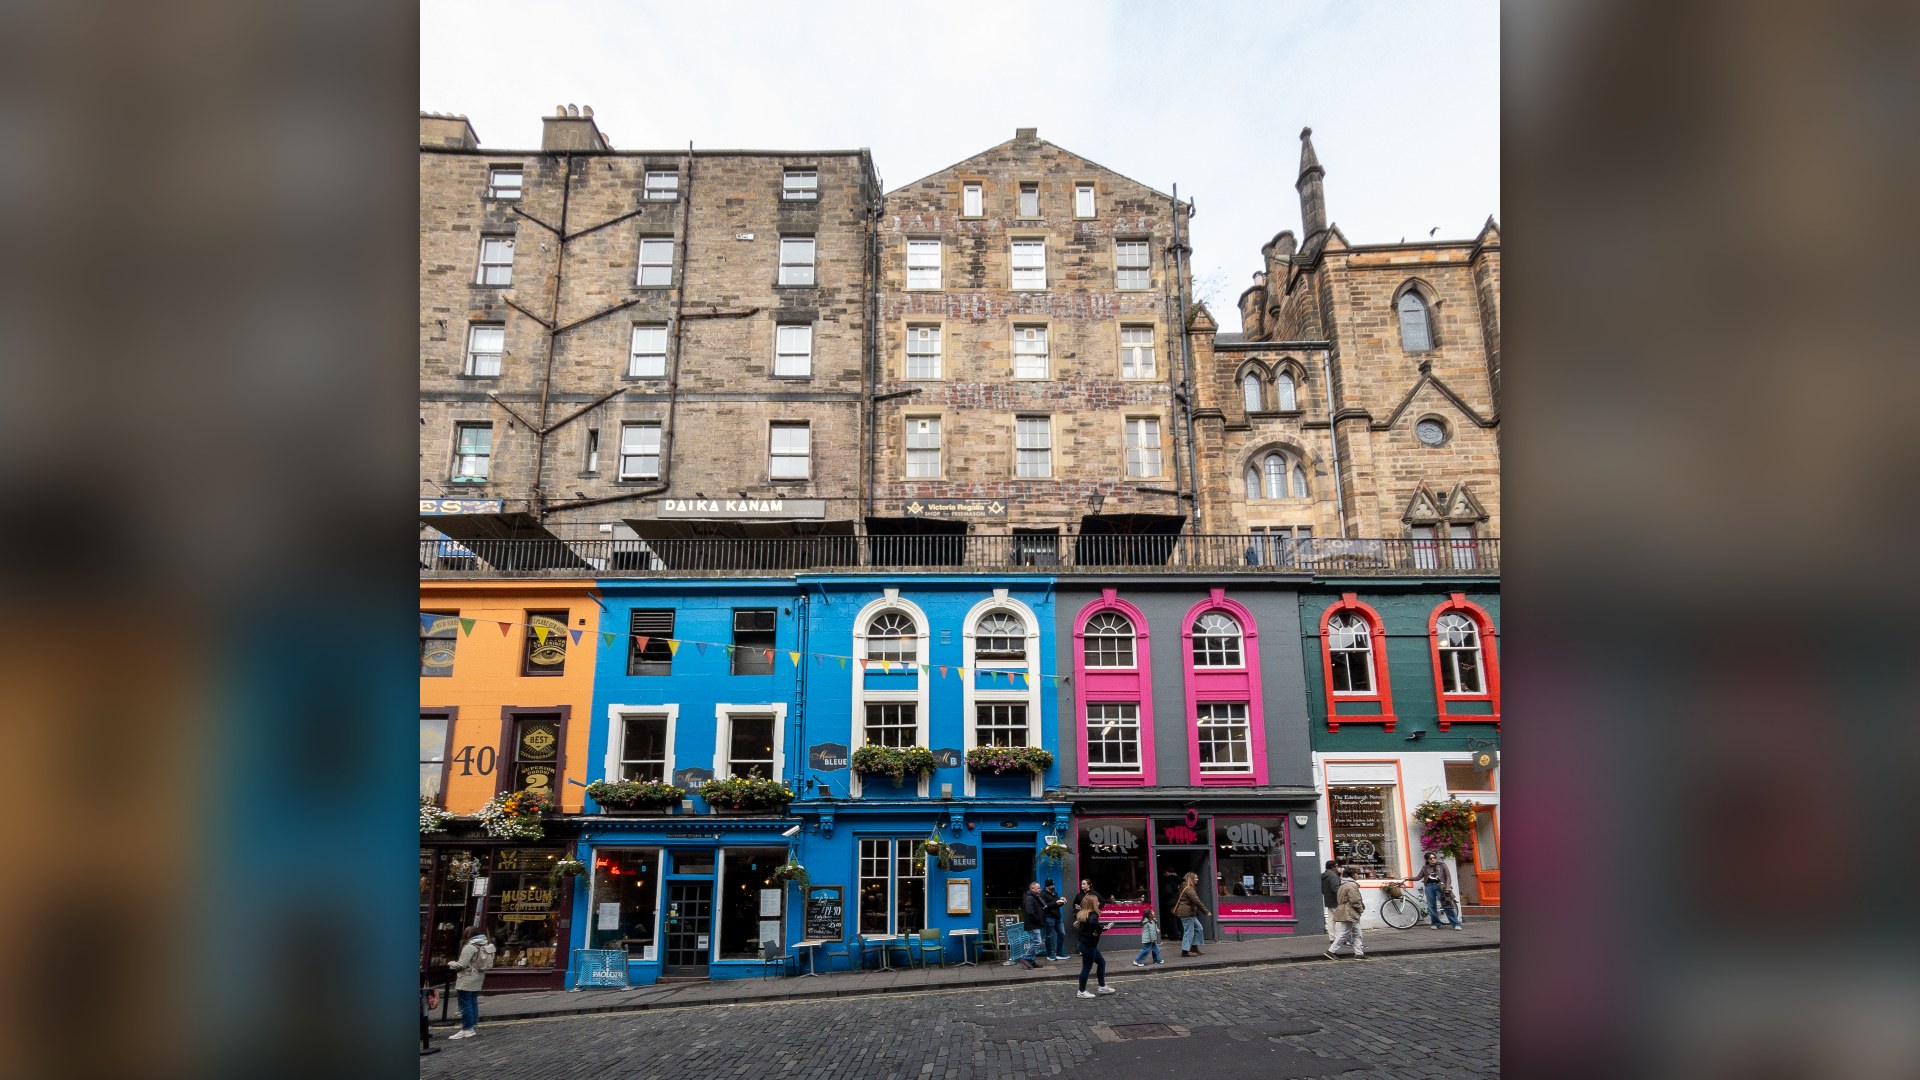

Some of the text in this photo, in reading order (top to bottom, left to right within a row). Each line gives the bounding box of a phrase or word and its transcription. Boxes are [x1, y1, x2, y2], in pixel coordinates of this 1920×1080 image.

[665, 500, 783, 512] DAIKA KANAM
[928, 503, 985, 512] Victoria Regalia
[1312, 539, 1354, 549] SHOP
[453, 745, 496, 776] 40
[824, 758, 847, 766] BLEUE
[950, 757, 958, 766] B
[521, 765, 556, 774] SUPERIOR
[524, 774, 549, 794] 2
[953, 858, 976, 866] BLEUE
[501, 890, 553, 903] MUSEUM
[509, 903, 541, 911] CONTEXT
